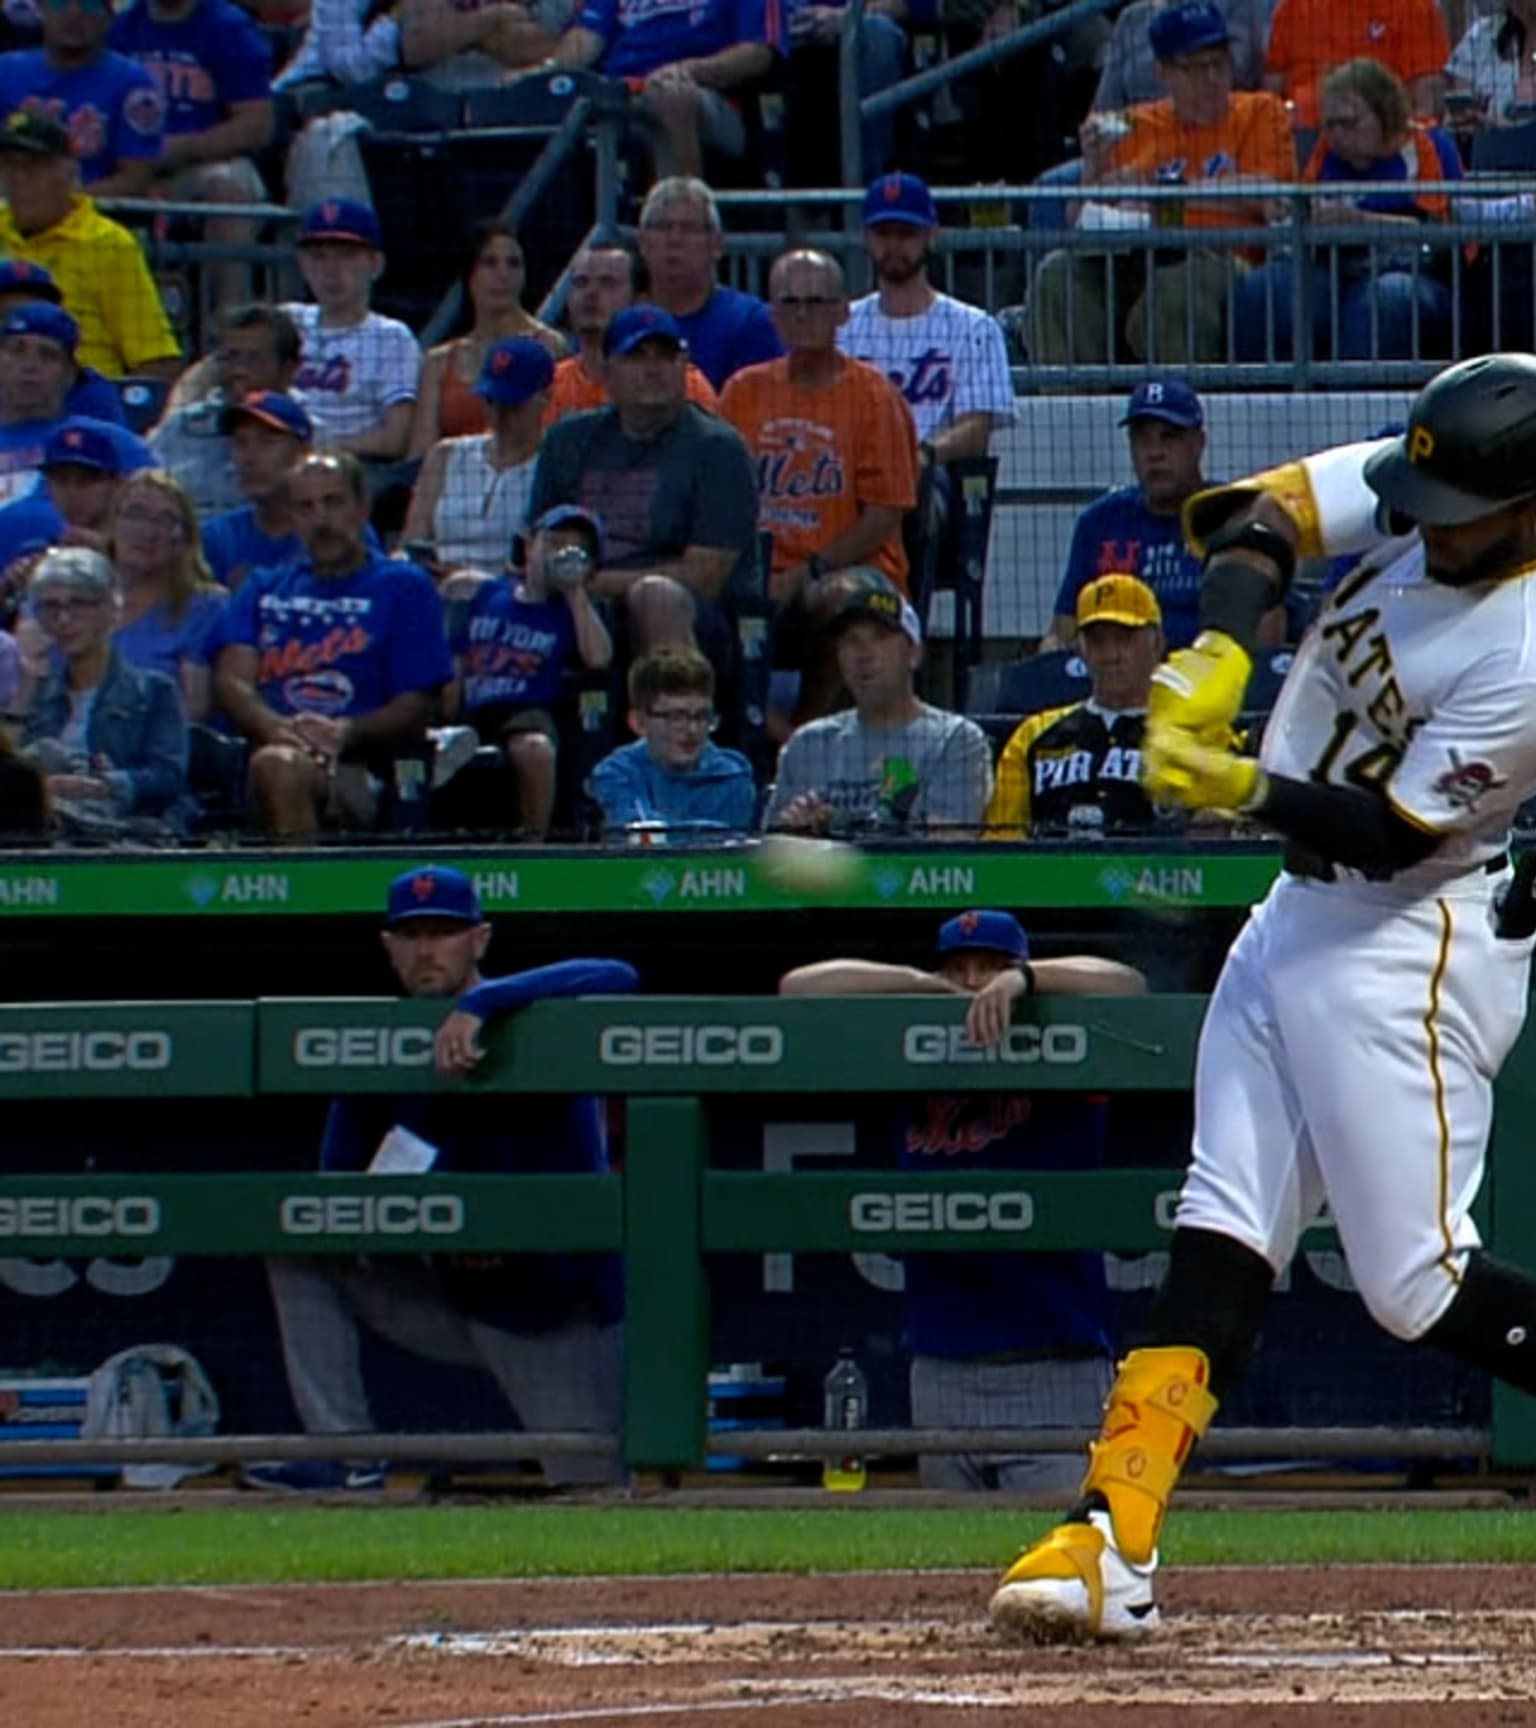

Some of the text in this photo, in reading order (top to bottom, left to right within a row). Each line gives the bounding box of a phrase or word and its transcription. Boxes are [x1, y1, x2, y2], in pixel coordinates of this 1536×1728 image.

[1409, 424, 1435, 462] P
[221, 874, 289, 902] AHN
[472, 872, 519, 900] HN
[679, 869, 745, 897] AHN
[908, 867, 975, 895] AHN
[1135, 867, 1203, 896] AHN
[294, 1028, 434, 1067] GEIC
[600, 1026, 784, 1065] GEICO
[280, 1195, 466, 1235] GEICO
[849, 1192, 1034, 1232] GEICO
